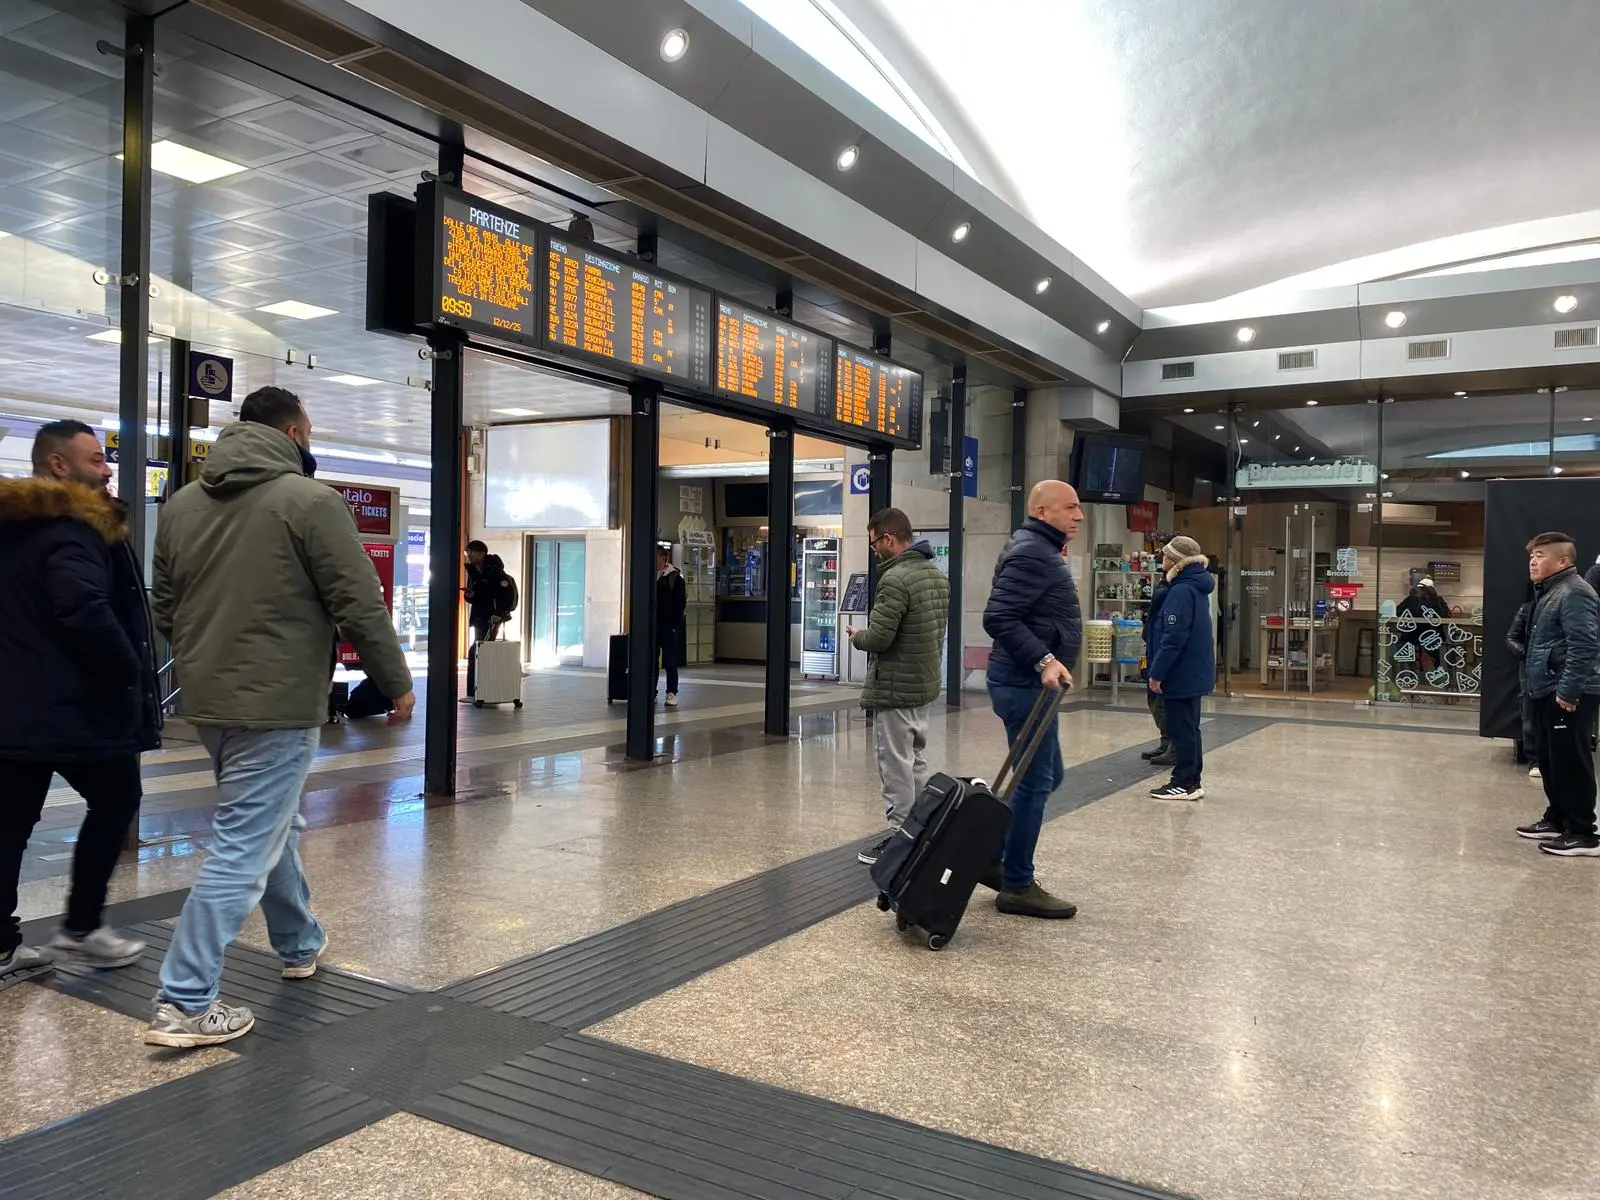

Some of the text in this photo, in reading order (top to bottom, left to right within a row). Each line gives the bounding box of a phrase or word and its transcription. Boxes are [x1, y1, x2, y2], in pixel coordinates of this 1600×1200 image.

[470, 207, 520, 238] PARTENZE
[584, 254, 620, 274] DESTINAZIONE
[442, 296, 472, 317] 09:59
[493, 318, 521, 331] 12/12/25
[362, 505, 388, 518] TICKETS
[370, 549, 389, 558] TICKETS
[342, 652, 360, 661] BIGLIE
[208, 1014, 218, 1025] N
